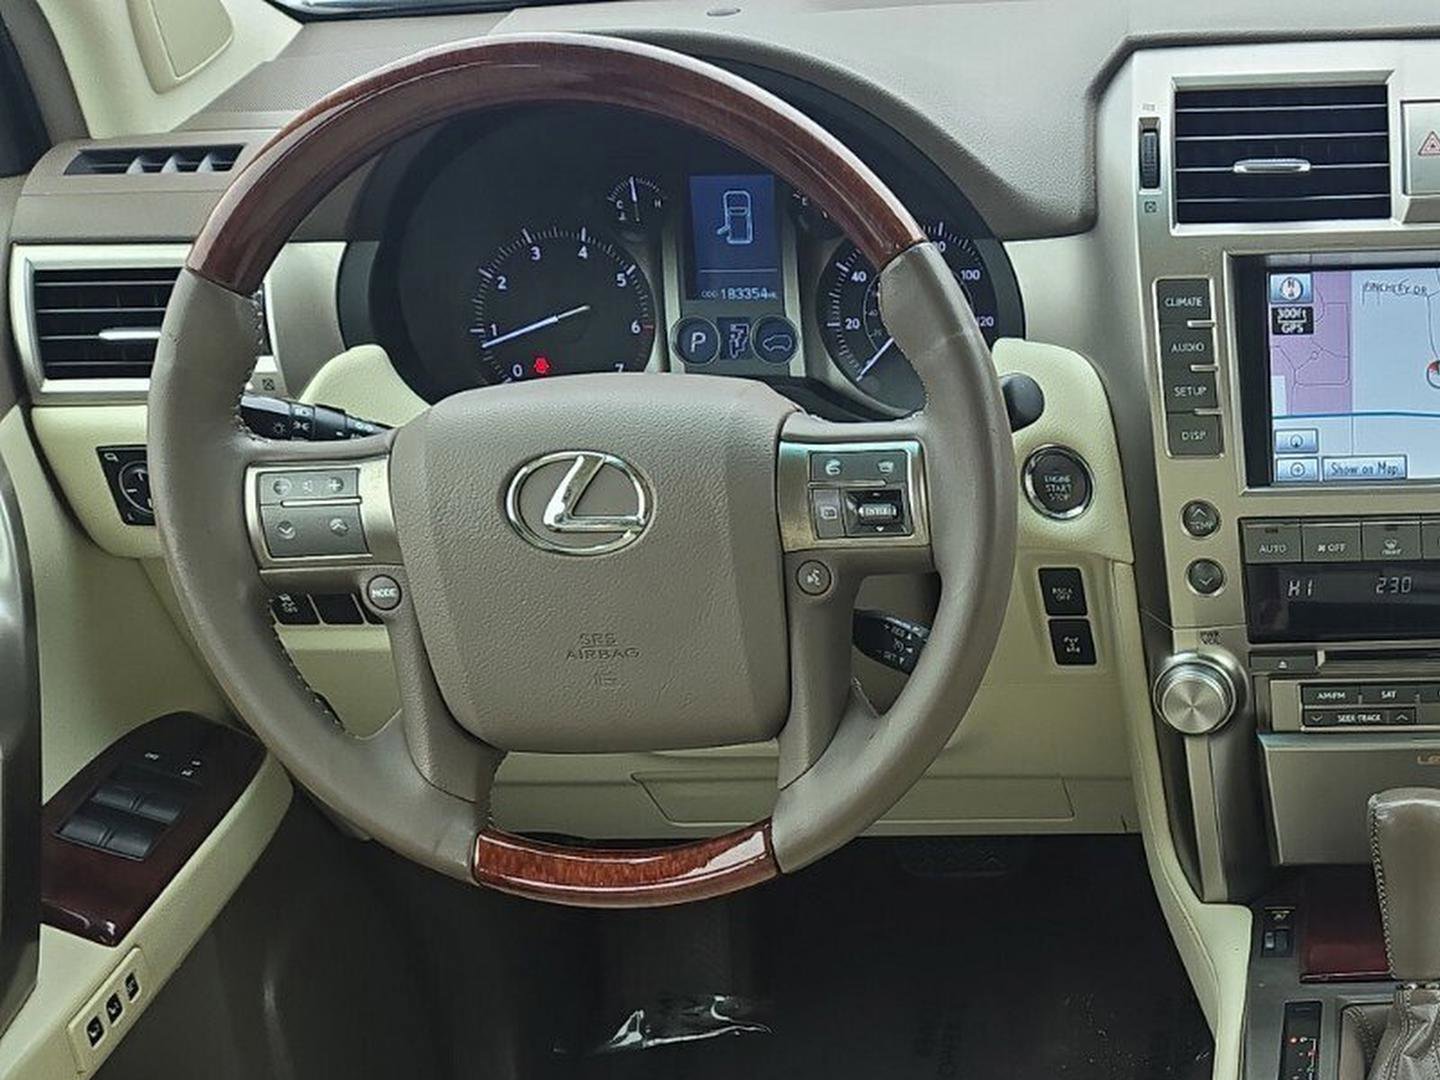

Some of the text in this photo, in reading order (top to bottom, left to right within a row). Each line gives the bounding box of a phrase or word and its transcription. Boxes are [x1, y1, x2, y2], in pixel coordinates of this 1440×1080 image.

[531, 246, 541, 261] 3
[577, 246, 588, 259] 4
[616, 273, 627, 288] 5
[851, 271, 867, 283] 40
[961, 269, 981, 280] 100
[497, 276, 507, 290] 2
[721, 288, 768, 300] 183354
[1164, 297, 1203, 307] CLIMATE
[490, 323, 498, 336] 1
[630, 320, 641, 334] 6
[845, 318, 861, 330] 20
[1281, 323, 1304, 333] GPS
[690, 332, 706, 352] P
[1171, 342, 1205, 353] AUDIO
[512, 364, 523, 377] 0
[1174, 386, 1208, 397] SETUP
[1331, 462, 1399, 476] Show on Map
[1258, 543, 1287, 554] AUTO
[1327, 543, 1346, 552] OFF
[565, 647, 640, 660] AIRBAG
[1381, 690, 1397, 699] SAT
